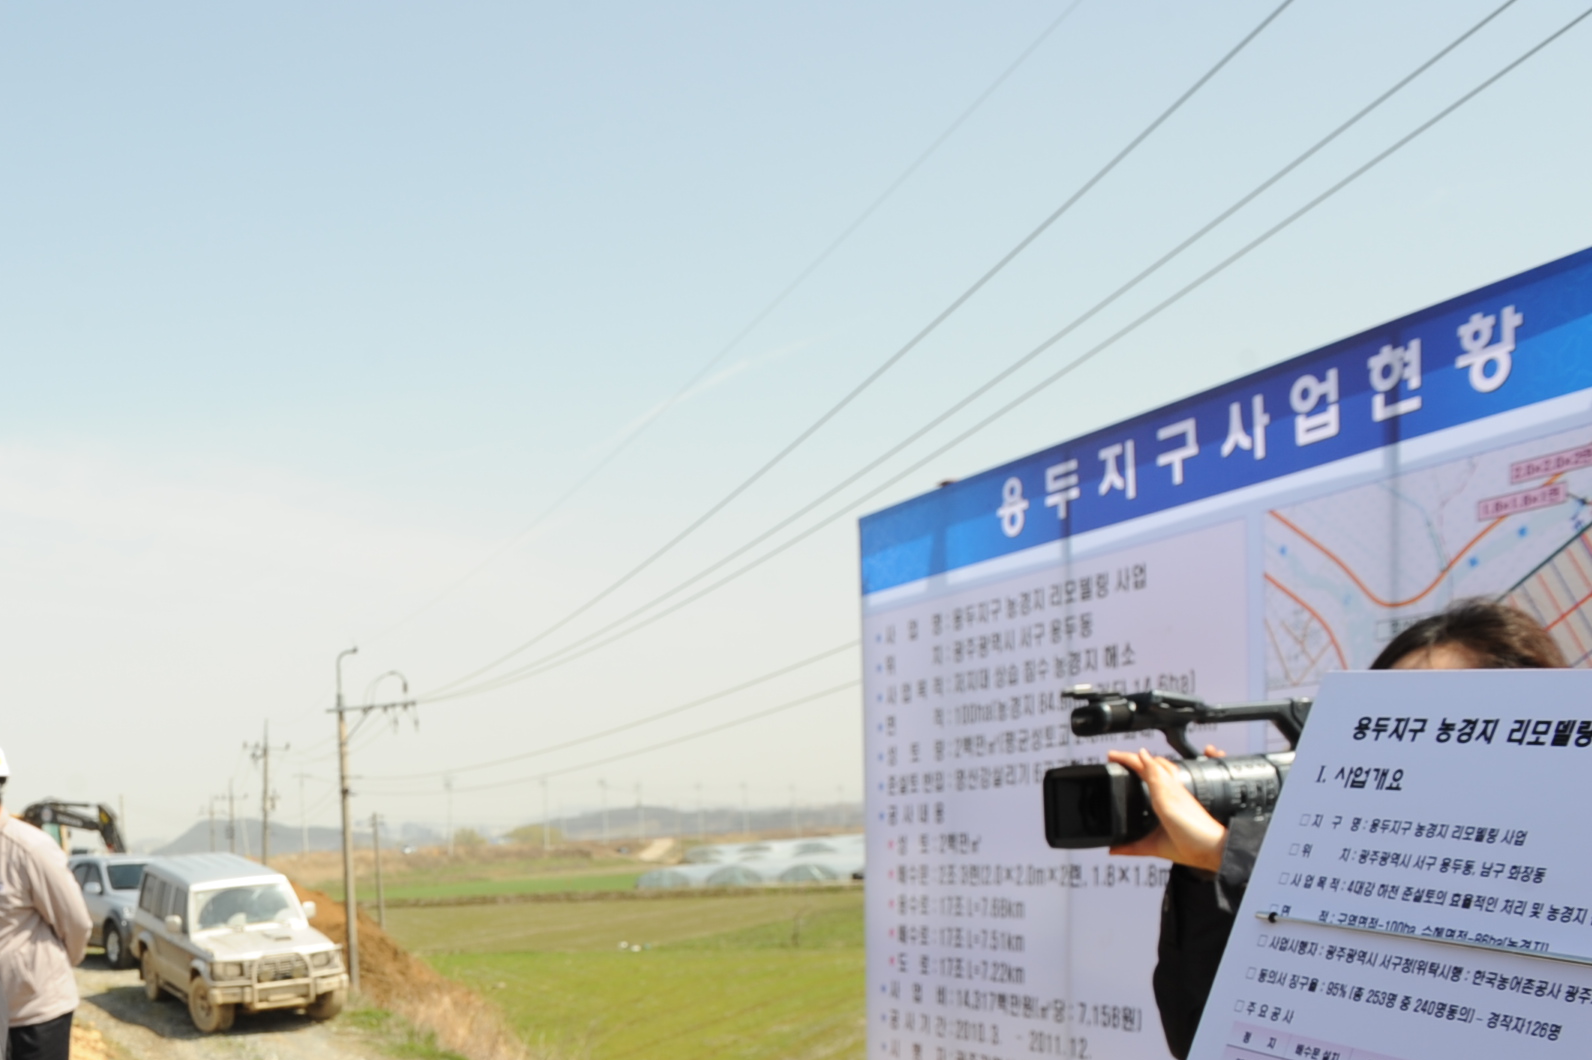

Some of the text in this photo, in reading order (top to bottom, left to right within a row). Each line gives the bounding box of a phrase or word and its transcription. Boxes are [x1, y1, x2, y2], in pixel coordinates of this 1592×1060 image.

[1117, 564, 1146, 591] 사업
[1353, 717, 1592, 747] 용두지구 농경지 리모델링
[1335, 767, 1403, 791] 사업개요
[1369, 819, 1527, 846] 용두지구 농경지 리모델링 사업
[1359, 850, 1412, 868] 광주광역시
[1413, 856, 1437, 870] 서구
[1480, 862, 1505, 878] 남구
[1507, 865, 1546, 883] 화장동
[1377, 884, 1400, 899] 하천
[1402, 887, 1447, 905] 준설토의
[1449, 893, 1498, 912] 효율적인
[1501, 899, 1527, 916] 처리
[1528, 902, 1545, 919] 및
[1547, 905, 1588, 924] 농경지
[1326, 945, 1378, 966] 광주광역시
[1472, 970, 1562, 999] 한국농어촌공사
[1258, 969, 1287, 986] 동의서
[1326, 982, 1346, 998] 95%
[1366, 989, 1398, 1008] 253명
[1399, 995, 1412, 1012] 중
[1487, 1012, 1562, 1041] 경작자126명
